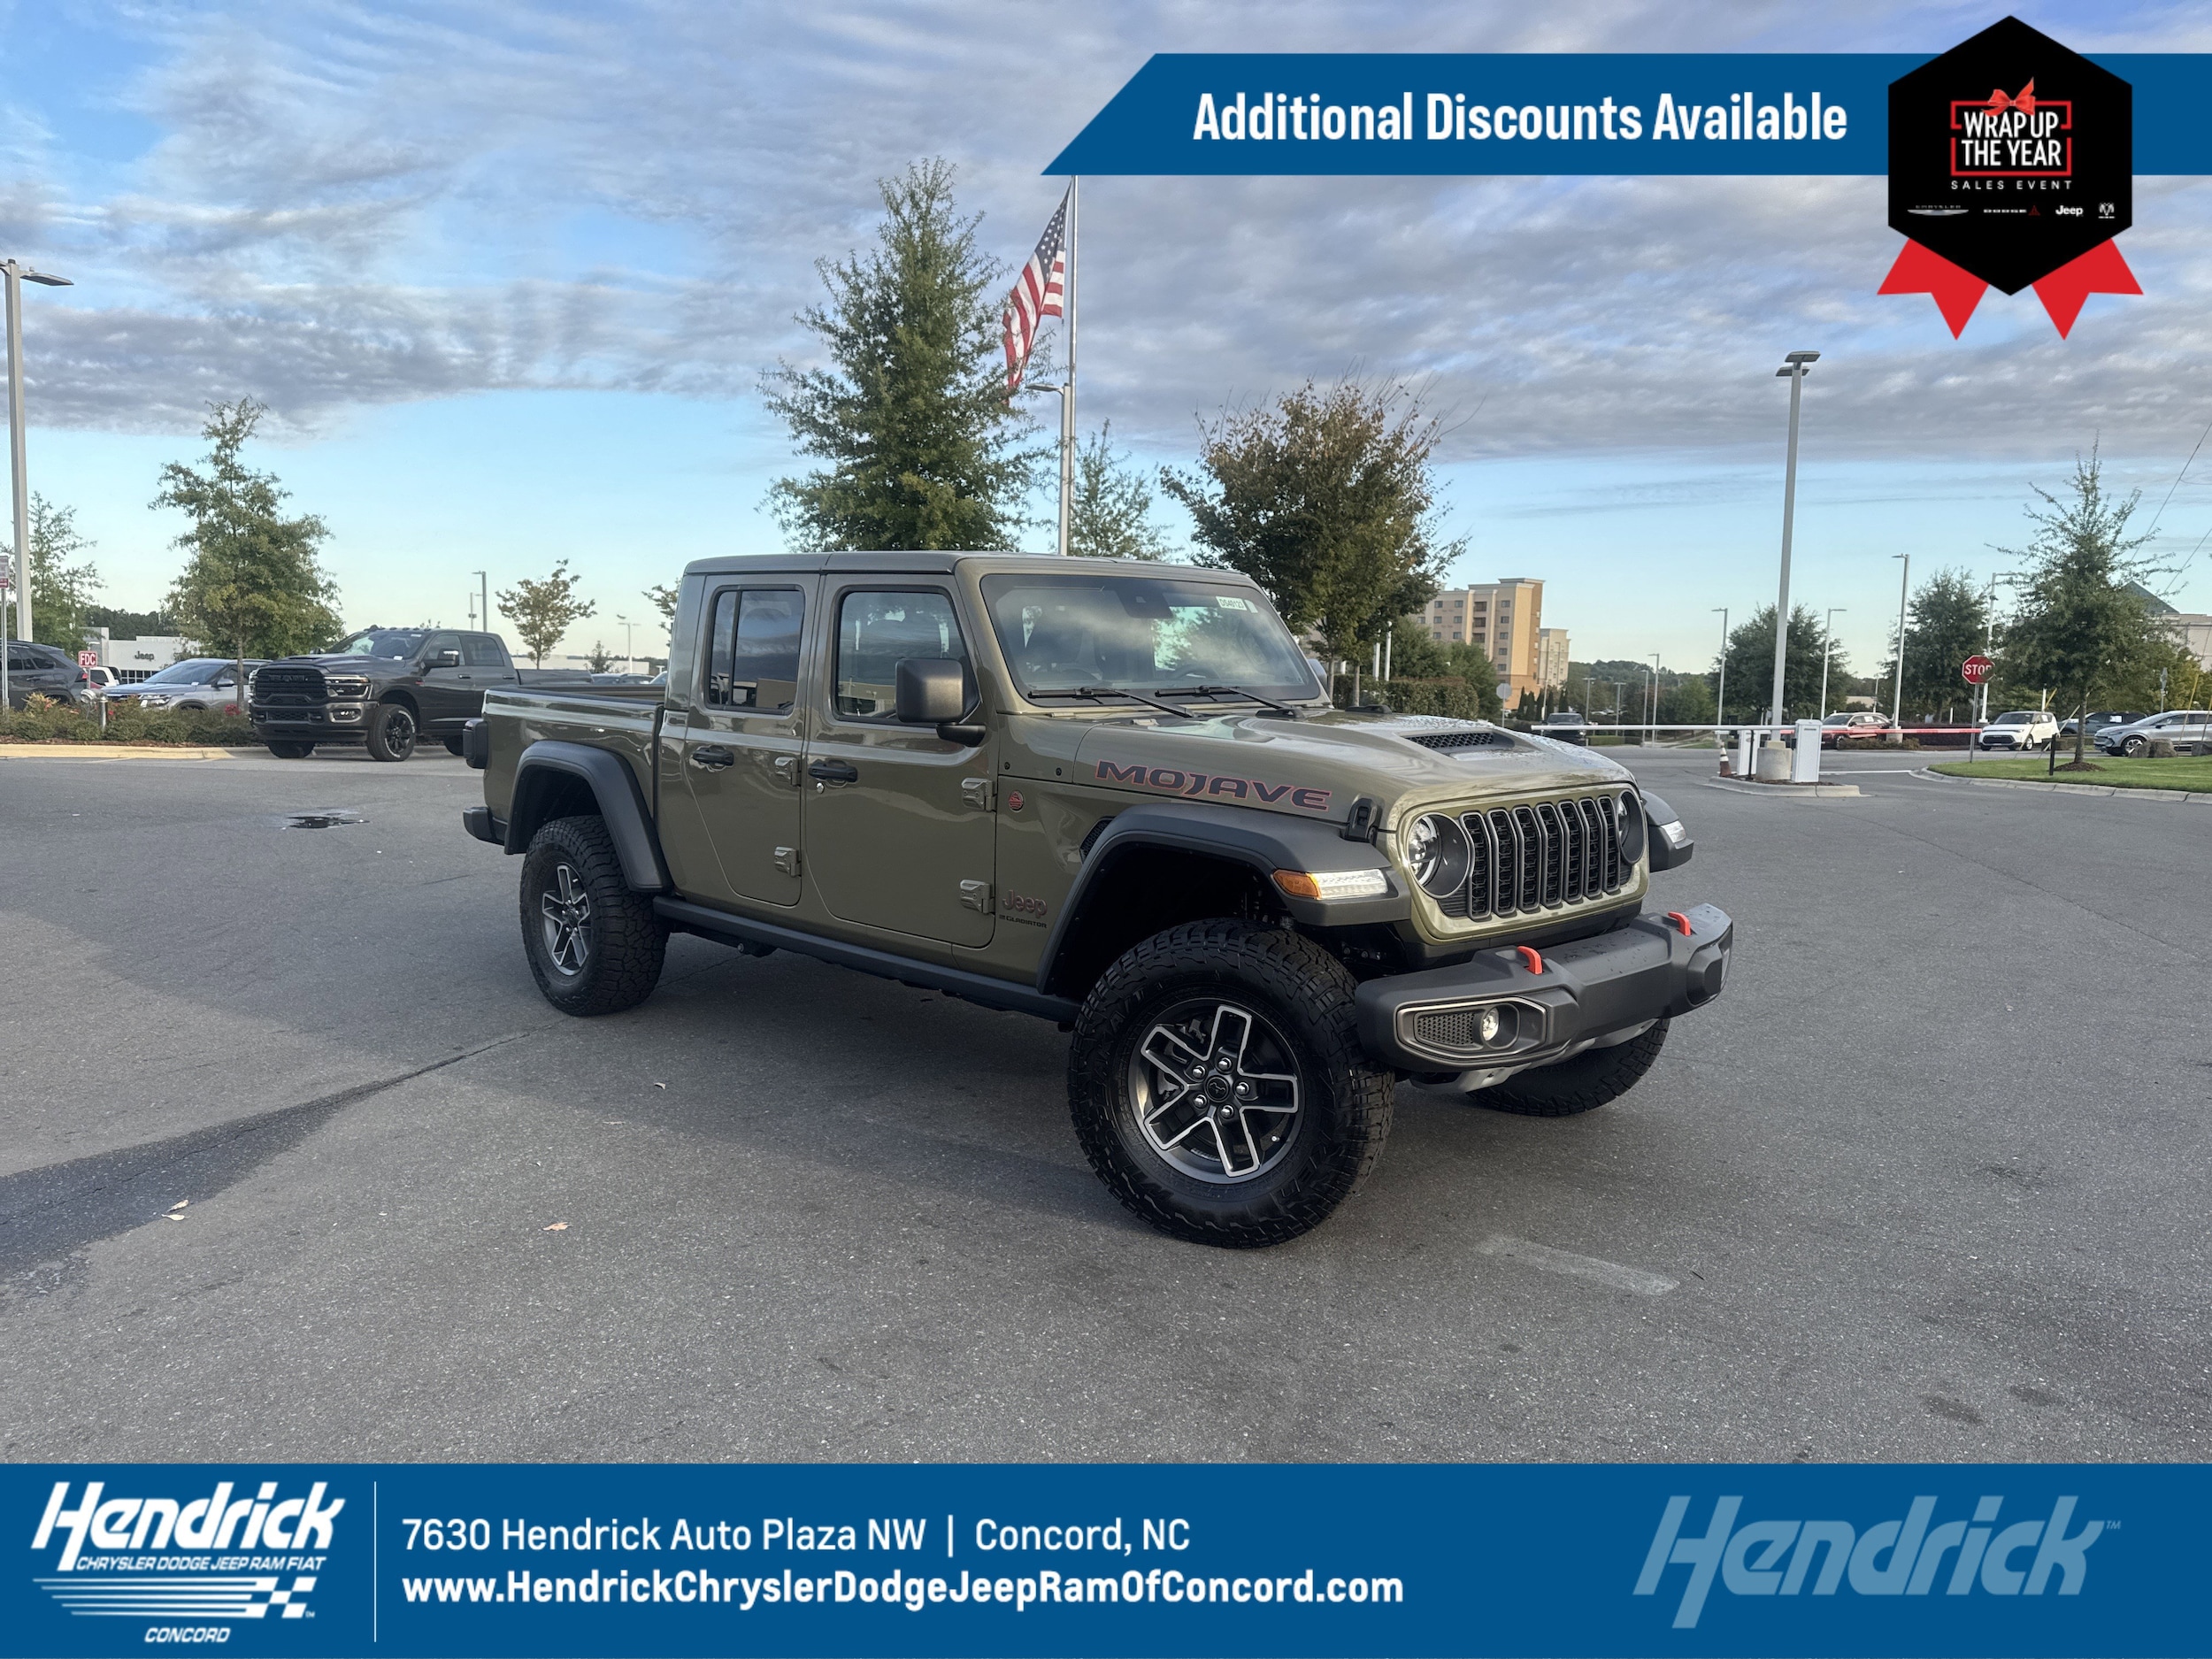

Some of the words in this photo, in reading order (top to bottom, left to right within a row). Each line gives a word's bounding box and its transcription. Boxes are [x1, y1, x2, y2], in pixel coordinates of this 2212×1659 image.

[80, 652, 96, 665] FDC
[134, 650, 155, 662] Jeep
[1095, 758, 1333, 813] MOJAVE
[1002, 889, 1048, 918] Jeep
[1006, 915, 1048, 928] GLADIATOR
